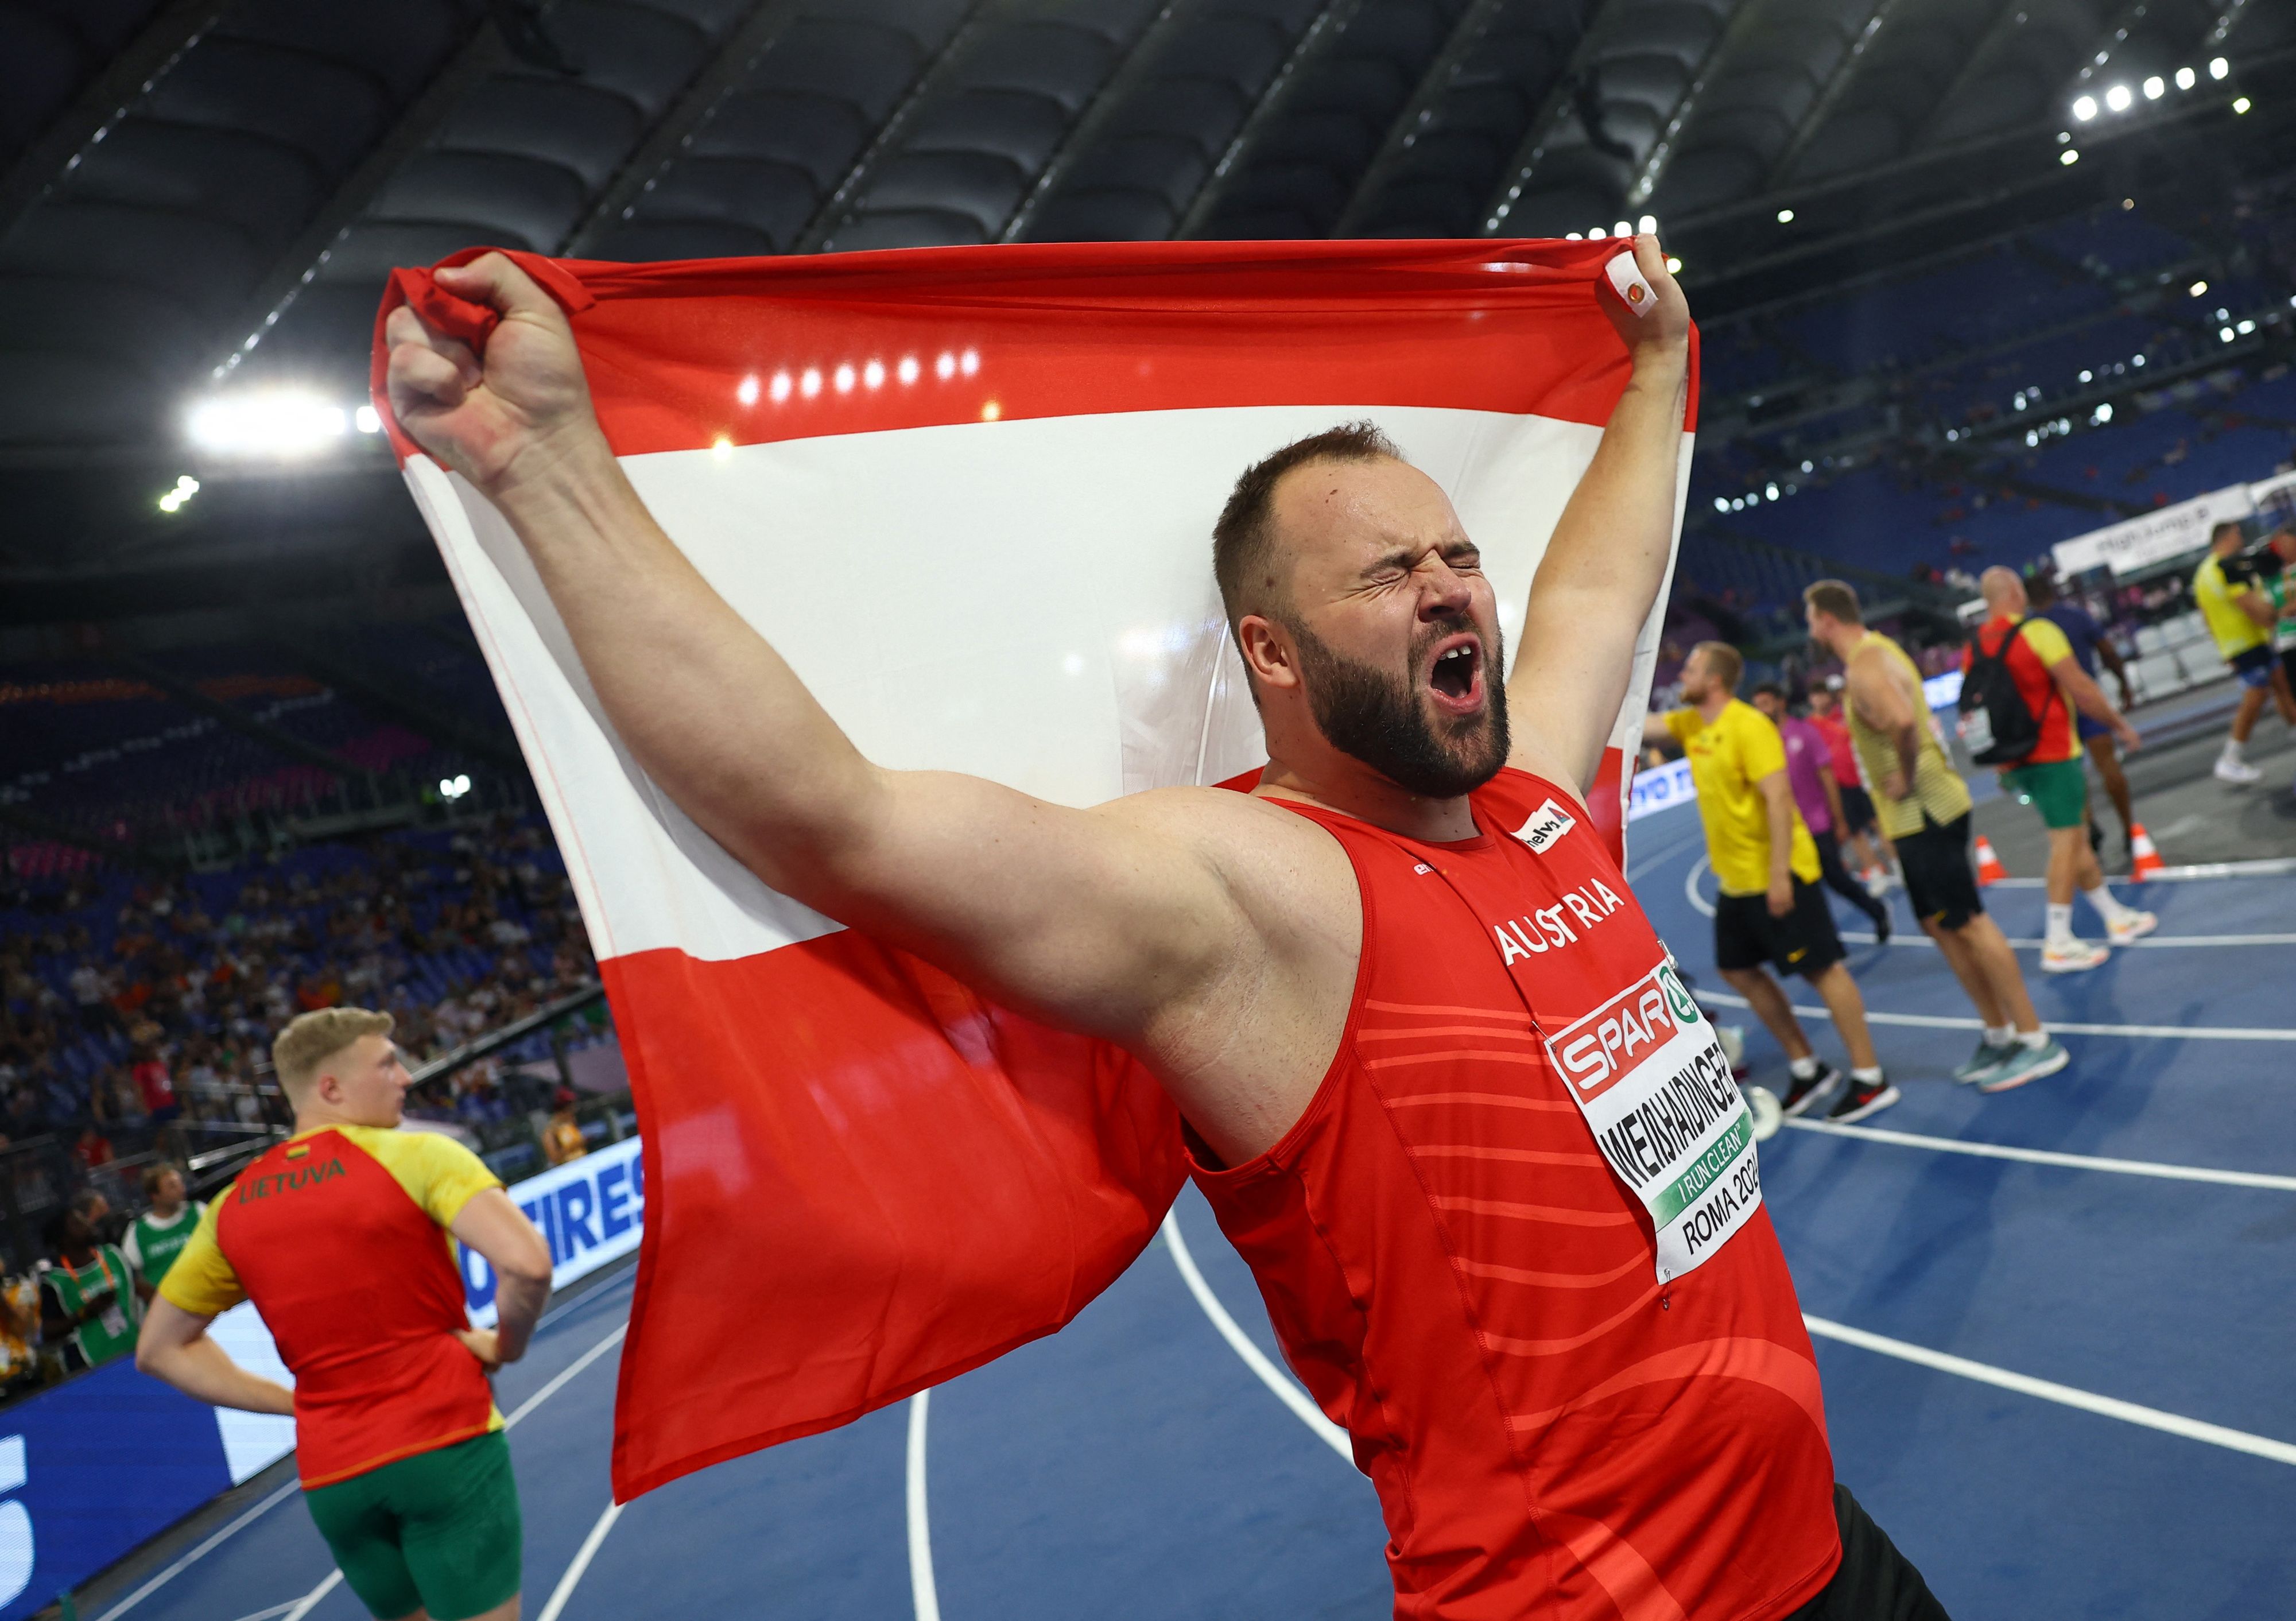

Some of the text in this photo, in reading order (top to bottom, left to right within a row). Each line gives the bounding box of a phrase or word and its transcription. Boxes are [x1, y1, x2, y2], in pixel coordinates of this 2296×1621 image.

[1494, 878, 1625, 967] AUSTRIA
[1562, 988, 1670, 1089] SPAR
[239, 1158, 346, 1205] LIETUVA
[1684, 1158, 1712, 1198] RUN
[1682, 1186, 1740, 1255] ROMA
